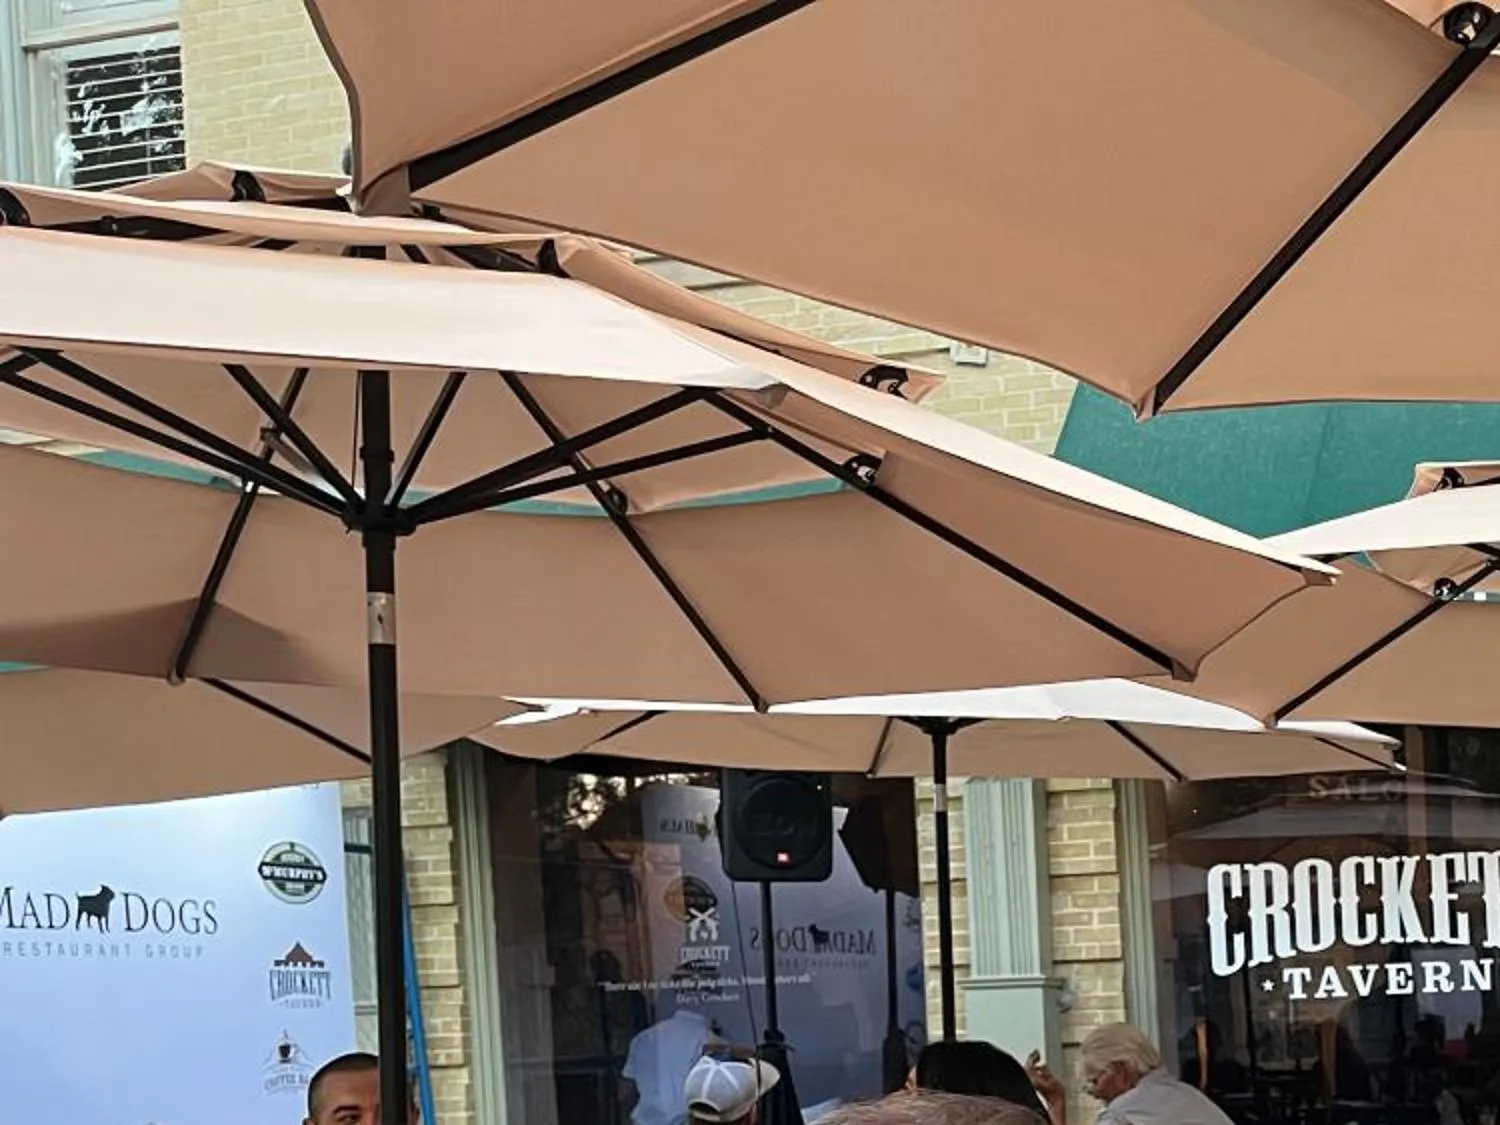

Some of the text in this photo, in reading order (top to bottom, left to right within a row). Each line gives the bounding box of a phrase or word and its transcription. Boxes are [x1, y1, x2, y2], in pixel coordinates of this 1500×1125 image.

[120, 891, 218, 935] DOGS
[3, 942, 203, 959] RESTAURANT GROUP
[1283, 958, 1495, 1000] TAVERN
